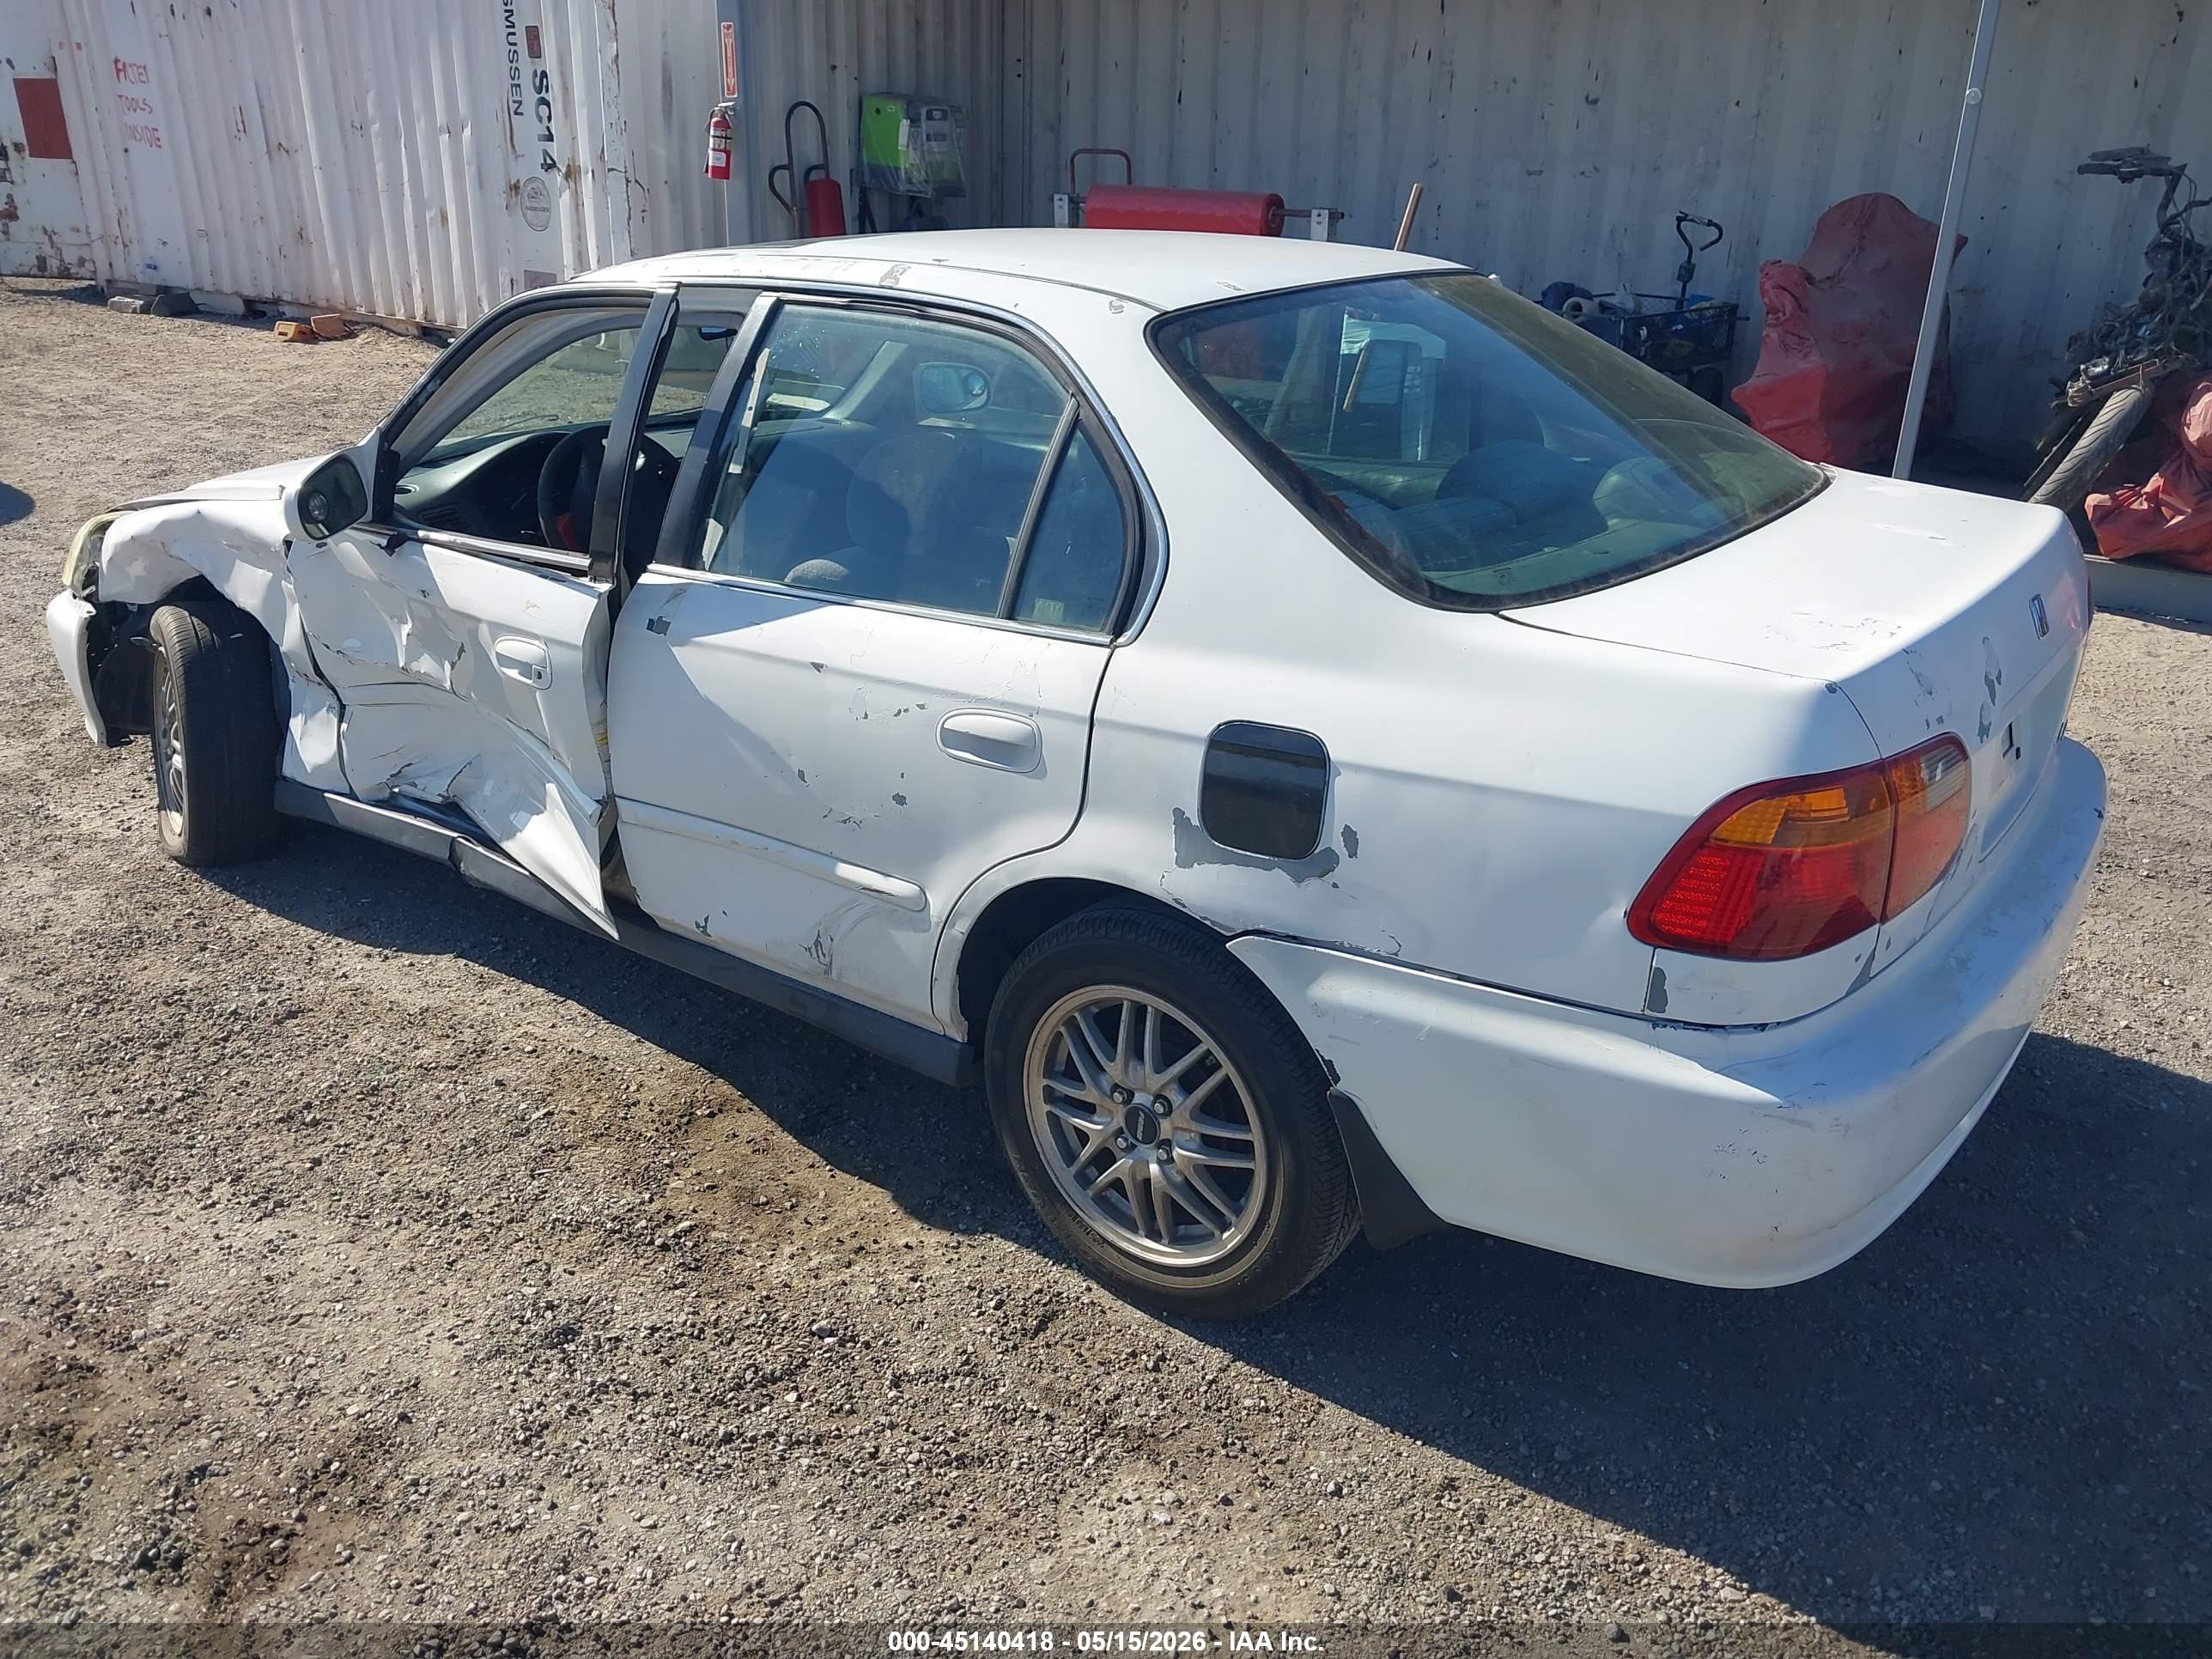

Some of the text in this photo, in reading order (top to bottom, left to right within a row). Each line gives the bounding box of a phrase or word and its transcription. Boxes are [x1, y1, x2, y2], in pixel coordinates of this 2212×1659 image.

[117, 94, 154, 116] TOOLS
[532, 68, 557, 172] SC14
[125, 123, 162, 149] INSIDE
